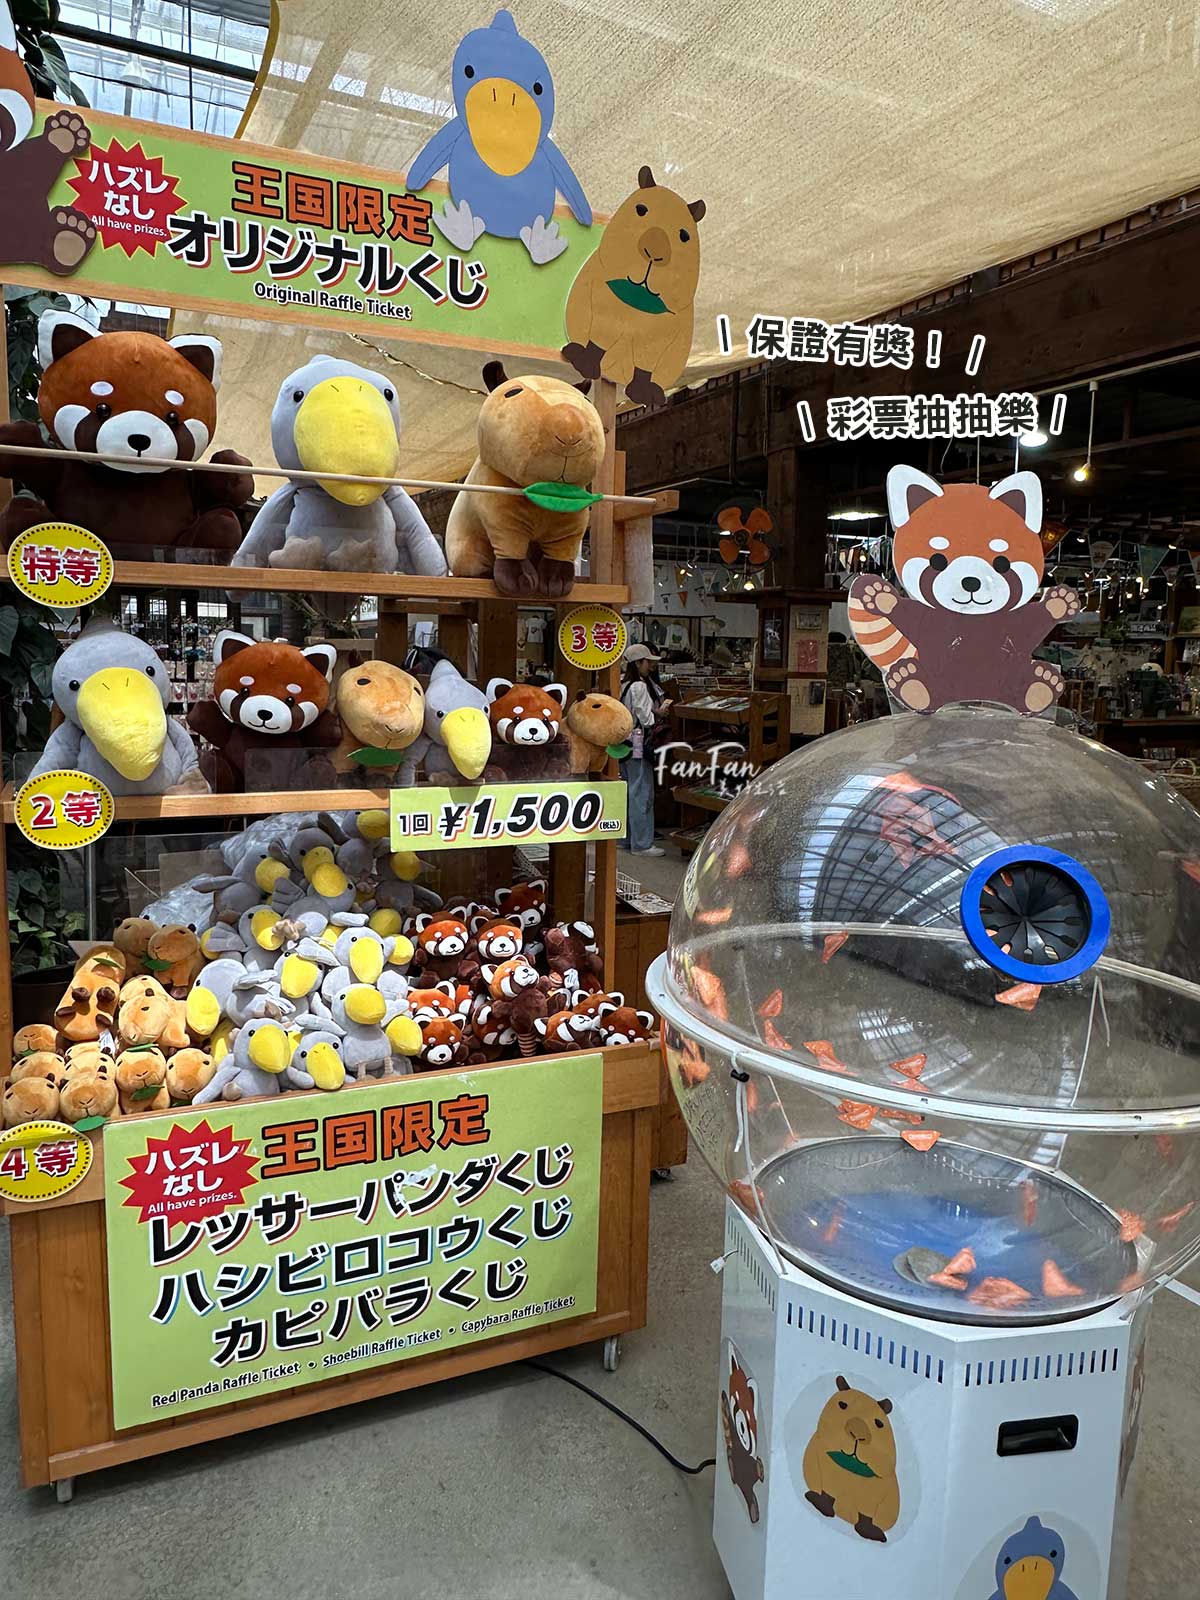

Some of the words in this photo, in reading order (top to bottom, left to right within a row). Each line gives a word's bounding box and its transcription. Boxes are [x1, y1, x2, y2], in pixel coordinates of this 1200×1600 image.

[88, 160, 169, 194] ハズレ
[103, 190, 155, 220] なし
[231, 160, 434, 246] 王国限定
[91, 215, 105, 226] All
[107, 217, 132, 230] have
[134, 223, 167, 236] prizes.
[165, 210, 488, 310] オリジナルくじ
[254, 282, 316, 304] Original
[320, 292, 364, 312] Raffle
[366, 298, 412, 320] Ticket
[22, 545, 101, 587] 特等
[399, 813, 431, 836] 1回
[261, 1093, 491, 1179] 王国限定
[144, 1141, 240, 1175] ハズレ
[147, 1202, 164, 1215] All
[167, 1198, 196, 1211] have
[199, 1191, 237, 1208] prizes.
[162, 1169, 224, 1197] なし
[148, 1143, 574, 1267] レッサーパンダくじ
[150, 1195, 572, 1325] ハシビロコウくじ
[211, 1257, 530, 1368] カピバラくじ
[152, 1390, 178, 1408] Red
[180, 1382, 220, 1401] Panda
[223, 1372, 260, 1391] Raffle
[262, 1363, 301, 1381] Ticket
[323, 1344, 370, 1368] Shoebill
[372, 1337, 405, 1354] Raffle
[407, 1328, 443, 1347] Ticket
[461, 1313, 511, 1334] Capybara
[511, 1303, 543, 1320] Raffle
[544, 1296, 577, 1313] Ticket
